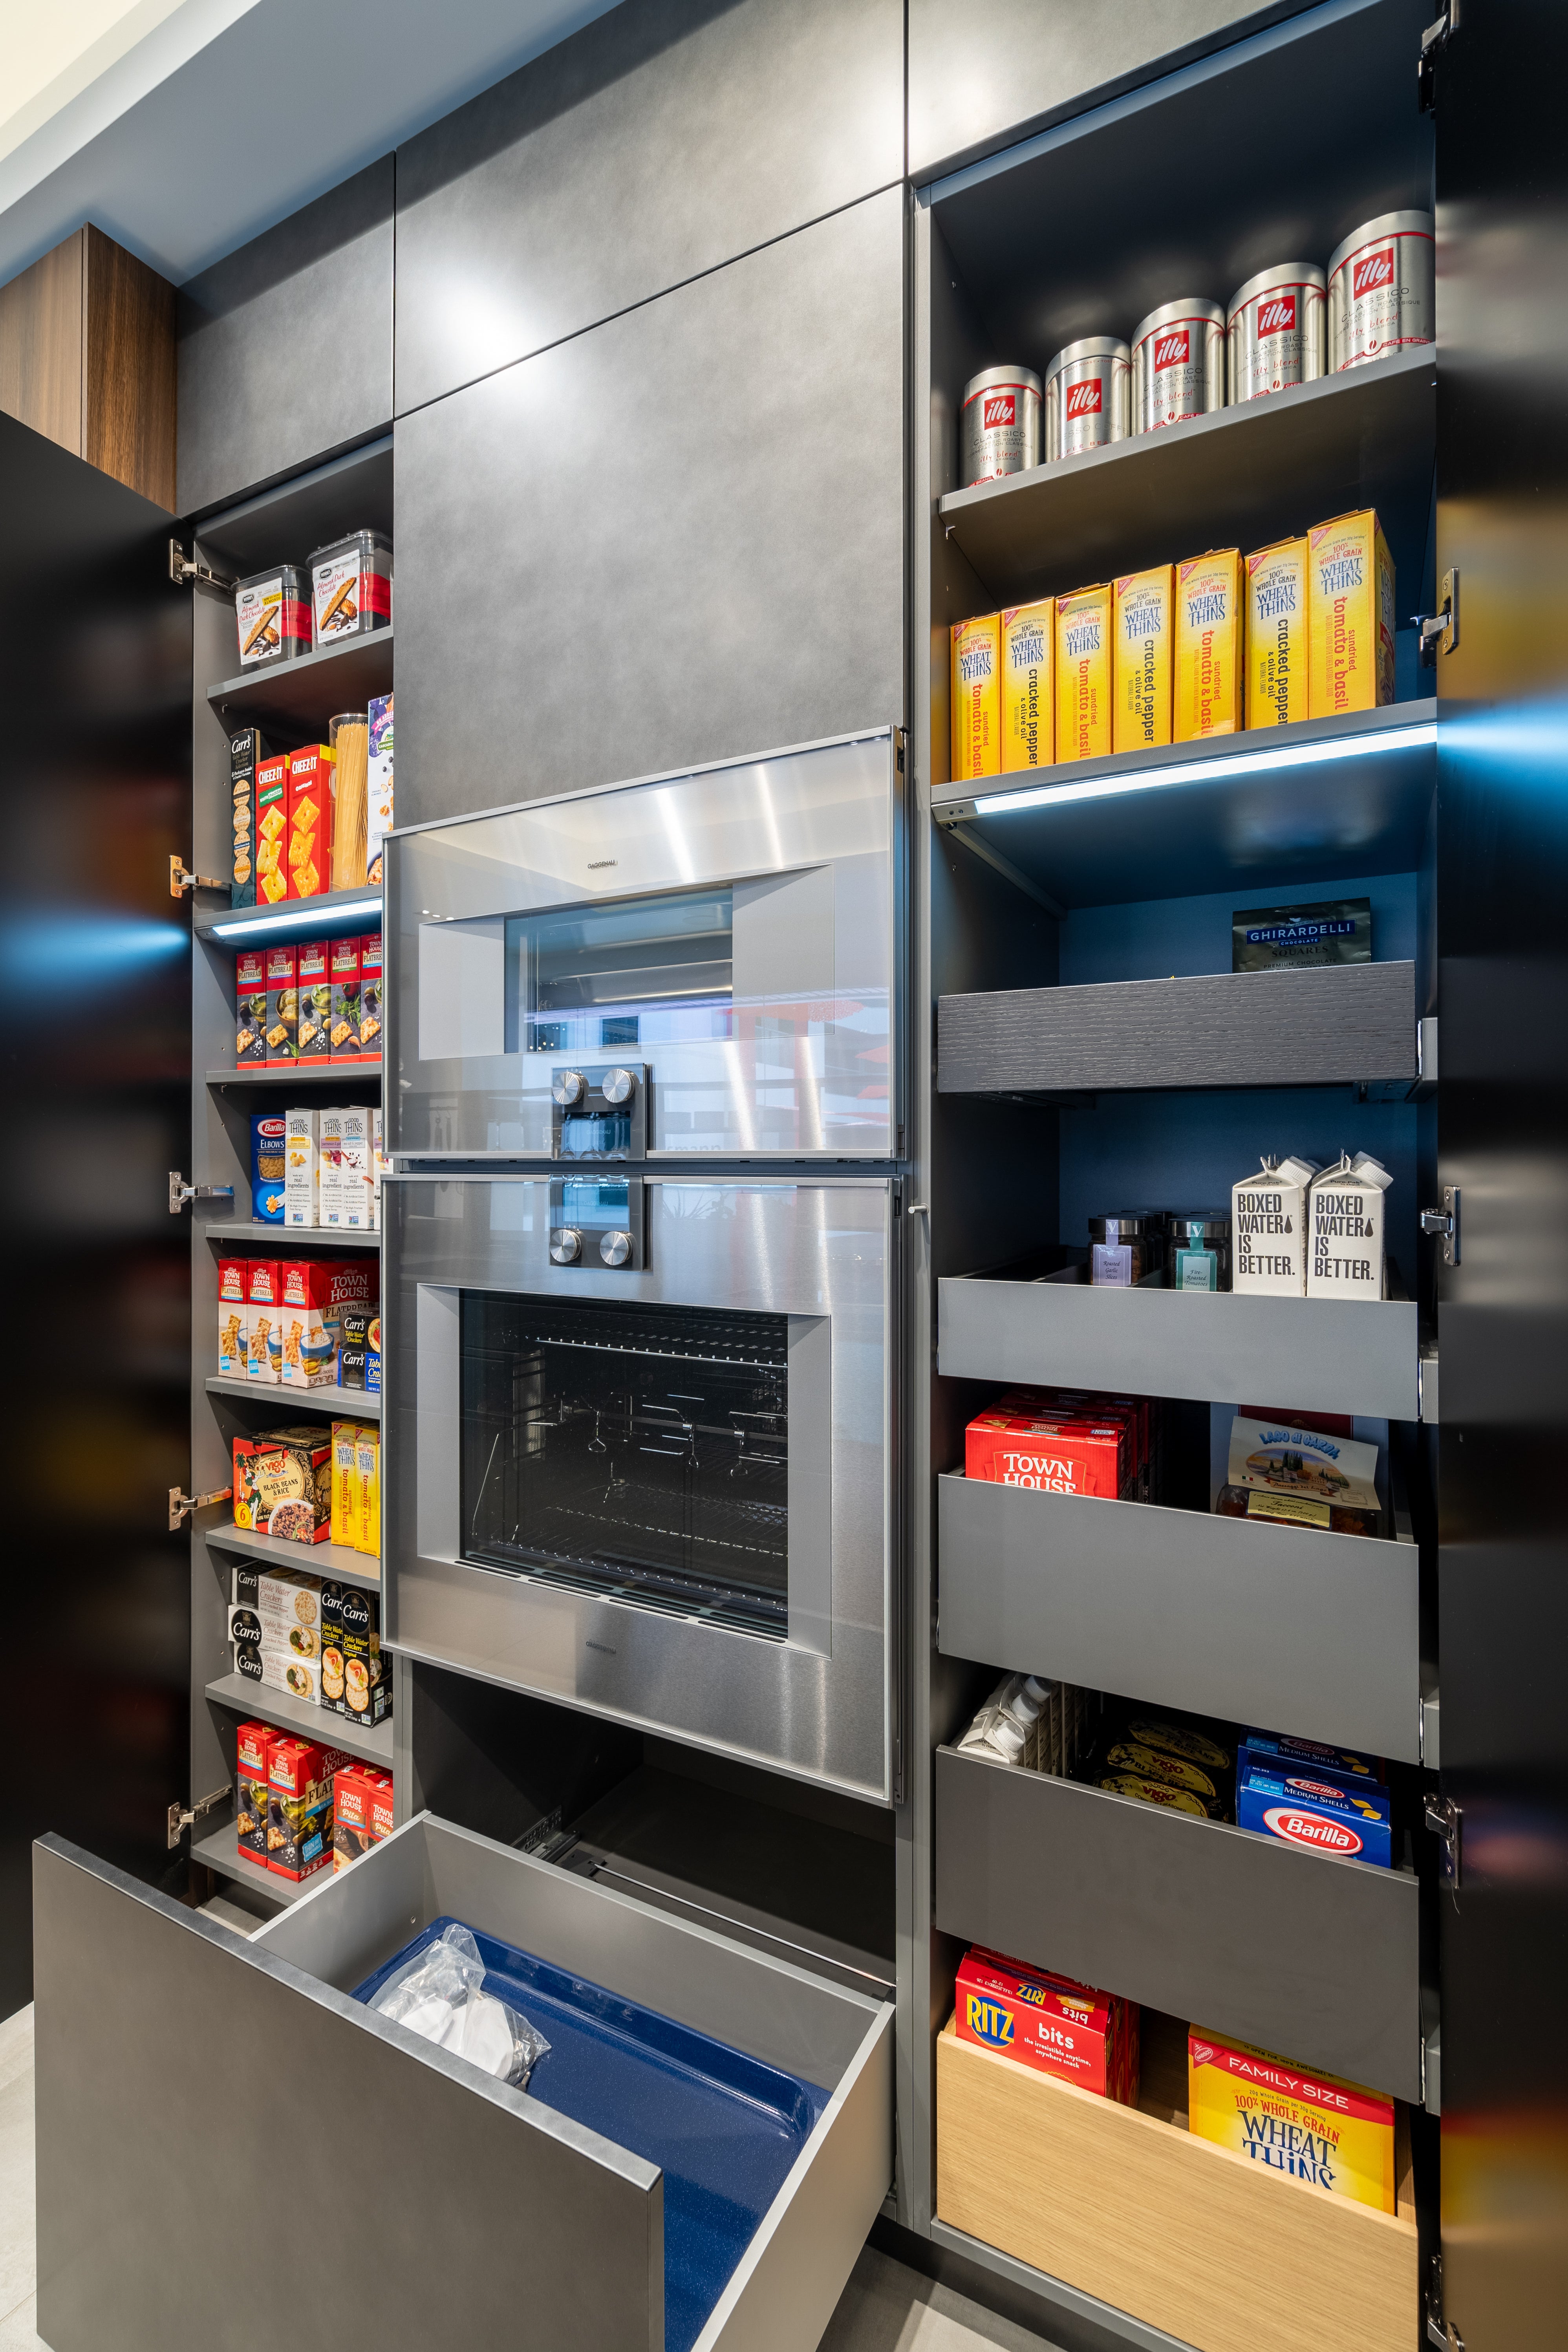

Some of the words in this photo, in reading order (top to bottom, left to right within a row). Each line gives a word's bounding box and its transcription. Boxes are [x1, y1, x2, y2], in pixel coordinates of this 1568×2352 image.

[1356, 258, 1391, 291] illy
[1342, 287, 1409, 322] CLASSICO
[1260, 303, 1293, 331] illy
[1156, 337, 1187, 364] illy
[1246, 335, 1308, 359] CLASSICO
[1344, 353, 1363, 367] BEANS
[1069, 385, 1100, 412] illy
[1169, 387, 1193, 400] blend
[986, 400, 1013, 424] illy
[1333, 542, 1348, 553] 100%
[1319, 550, 1341, 566] WHOLE
[1343, 548, 1362, 557] GRAIN
[1269, 569, 1283, 579] 100%
[1319, 557, 1363, 579] WHEAT
[317, 577, 334, 591] Almond
[334, 570, 345, 583] Dark
[1200, 578, 1214, 588] 100%
[1256, 579, 1275, 592] WHOLE
[1278, 575, 1296, 584] GRAIN
[318, 584, 336, 597] Chocolate
[1136, 592, 1149, 601] 100%
[1187, 588, 1206, 600] WHOLE
[1256, 584, 1296, 603] WHEAT
[242, 600, 260, 614] Almond
[1124, 600, 1144, 613] WHOLE
[1145, 598, 1161, 606] GRAIN
[1187, 593, 1226, 612] WHEAT
[1065, 621, 1083, 630] WHOLE
[1085, 616, 1100, 625] GRAIN
[1124, 607, 1161, 624] WHEAT
[1334, 596, 1348, 653] tomato
[1021, 624, 1033, 632] 100%
[1065, 624, 1100, 642] WHEAT
[1010, 637, 1044, 654] WHEAT
[1348, 629, 1357, 671] sundried
[960, 651, 992, 668] WHEAT
[1144, 639, 1156, 690] cracked
[1202, 630, 1215, 685] tomato
[1029, 669, 1039, 717] cracked
[1079, 659, 1090, 710] tomato
[1335, 670, 1349, 710] basil
[1141, 696, 1154, 742] pepper
[1201, 699, 1213, 736] basil
[1026, 722, 1038, 765] pepper
[1079, 724, 1091, 758] basil
[587, 860, 615, 869] GAGGENAU
[1250, 923, 1350, 941] GHIRARDELLI
[1271, 946, 1328, 957] SQUARES
[269, 966, 292, 974] FLATBREAD
[301, 961, 323, 970] FLATBREAD
[333, 958, 356, 967] FLATBREAD
[239, 970, 261, 980] FLATBREAD
[264, 1123, 285, 1132] Barilla
[289, 1122, 308, 1133] THINS
[1237, 1193, 1282, 1213] BOXED
[1316, 1194, 1363, 1215] BOXED
[1238, 1214, 1284, 1234] WATER
[1316, 1215, 1364, 1237] WATER
[1239, 1234, 1251, 1254] IS
[1315, 1236, 1329, 1256] IS
[1239, 1255, 1295, 1276] BETTER.
[1315, 1257, 1374, 1280] BETTER.
[344, 1318, 365, 1331] Carr's
[343, 1352, 364, 1366] Carr's
[337, 1448, 355, 1457] WHEAT
[1259, 1430, 1290, 1445] LAGO
[1291, 1433, 1303, 1443] di
[1303, 1434, 1341, 1460] GARDA
[1003, 1453, 1074, 1480] TOWN
[263, 1482, 280, 1491] BLACK
[281, 1479, 298, 1487] BEANS
[240, 1508, 246, 1521] 6
[238, 1572, 258, 1587] Carr's
[260, 1581, 274, 1591] Table
[275, 1585, 290, 1596] Water
[260, 1591, 283, 1604] Crackers
[233, 1622, 261, 1640] Carr's
[263, 1627, 284, 1637] Crackers
[321, 1638, 333, 1646] Original
[238, 1655, 262, 1675] Carr's
[1292, 1741, 1328, 1753] Barilla
[239, 1750, 262, 1764] FLATBREAD
[1299, 1783, 1337, 1796] Barilla
[342, 1808, 360, 1821] Pita
[1163, 1802, 1187, 1813] SEASONED
[1286, 1818, 1350, 1847] Barilla
[1015, 1984, 1047, 2006] RITZ
[967, 1993, 1015, 2044] RITZ
[1062, 2007, 1089, 2024] bits
[1038, 2023, 1074, 2049] bits
[1034, 2041, 1065, 2057] irresistible
[1065, 2053, 1091, 2067] anytime,
[1035, 2049, 1062, 2062] anywhere
[1063, 2059, 1080, 2069] snack
[1195, 2048, 1212, 2061] NABISCO
[1229, 2057, 1299, 2090] FAMILY
[1303, 2085, 1349, 2110] SIZE
[1260, 2092, 1275, 2100] Whole
[1276, 2096, 1290, 2105] Grain
[1300, 2105, 1308, 2114] 30g
[1309, 2110, 1326, 2122] Serving
[1234, 2094, 1259, 2109] 100%
[1260, 2100, 1299, 2123] WHOLE
[1303, 2115, 1340, 2144] GRAIN
